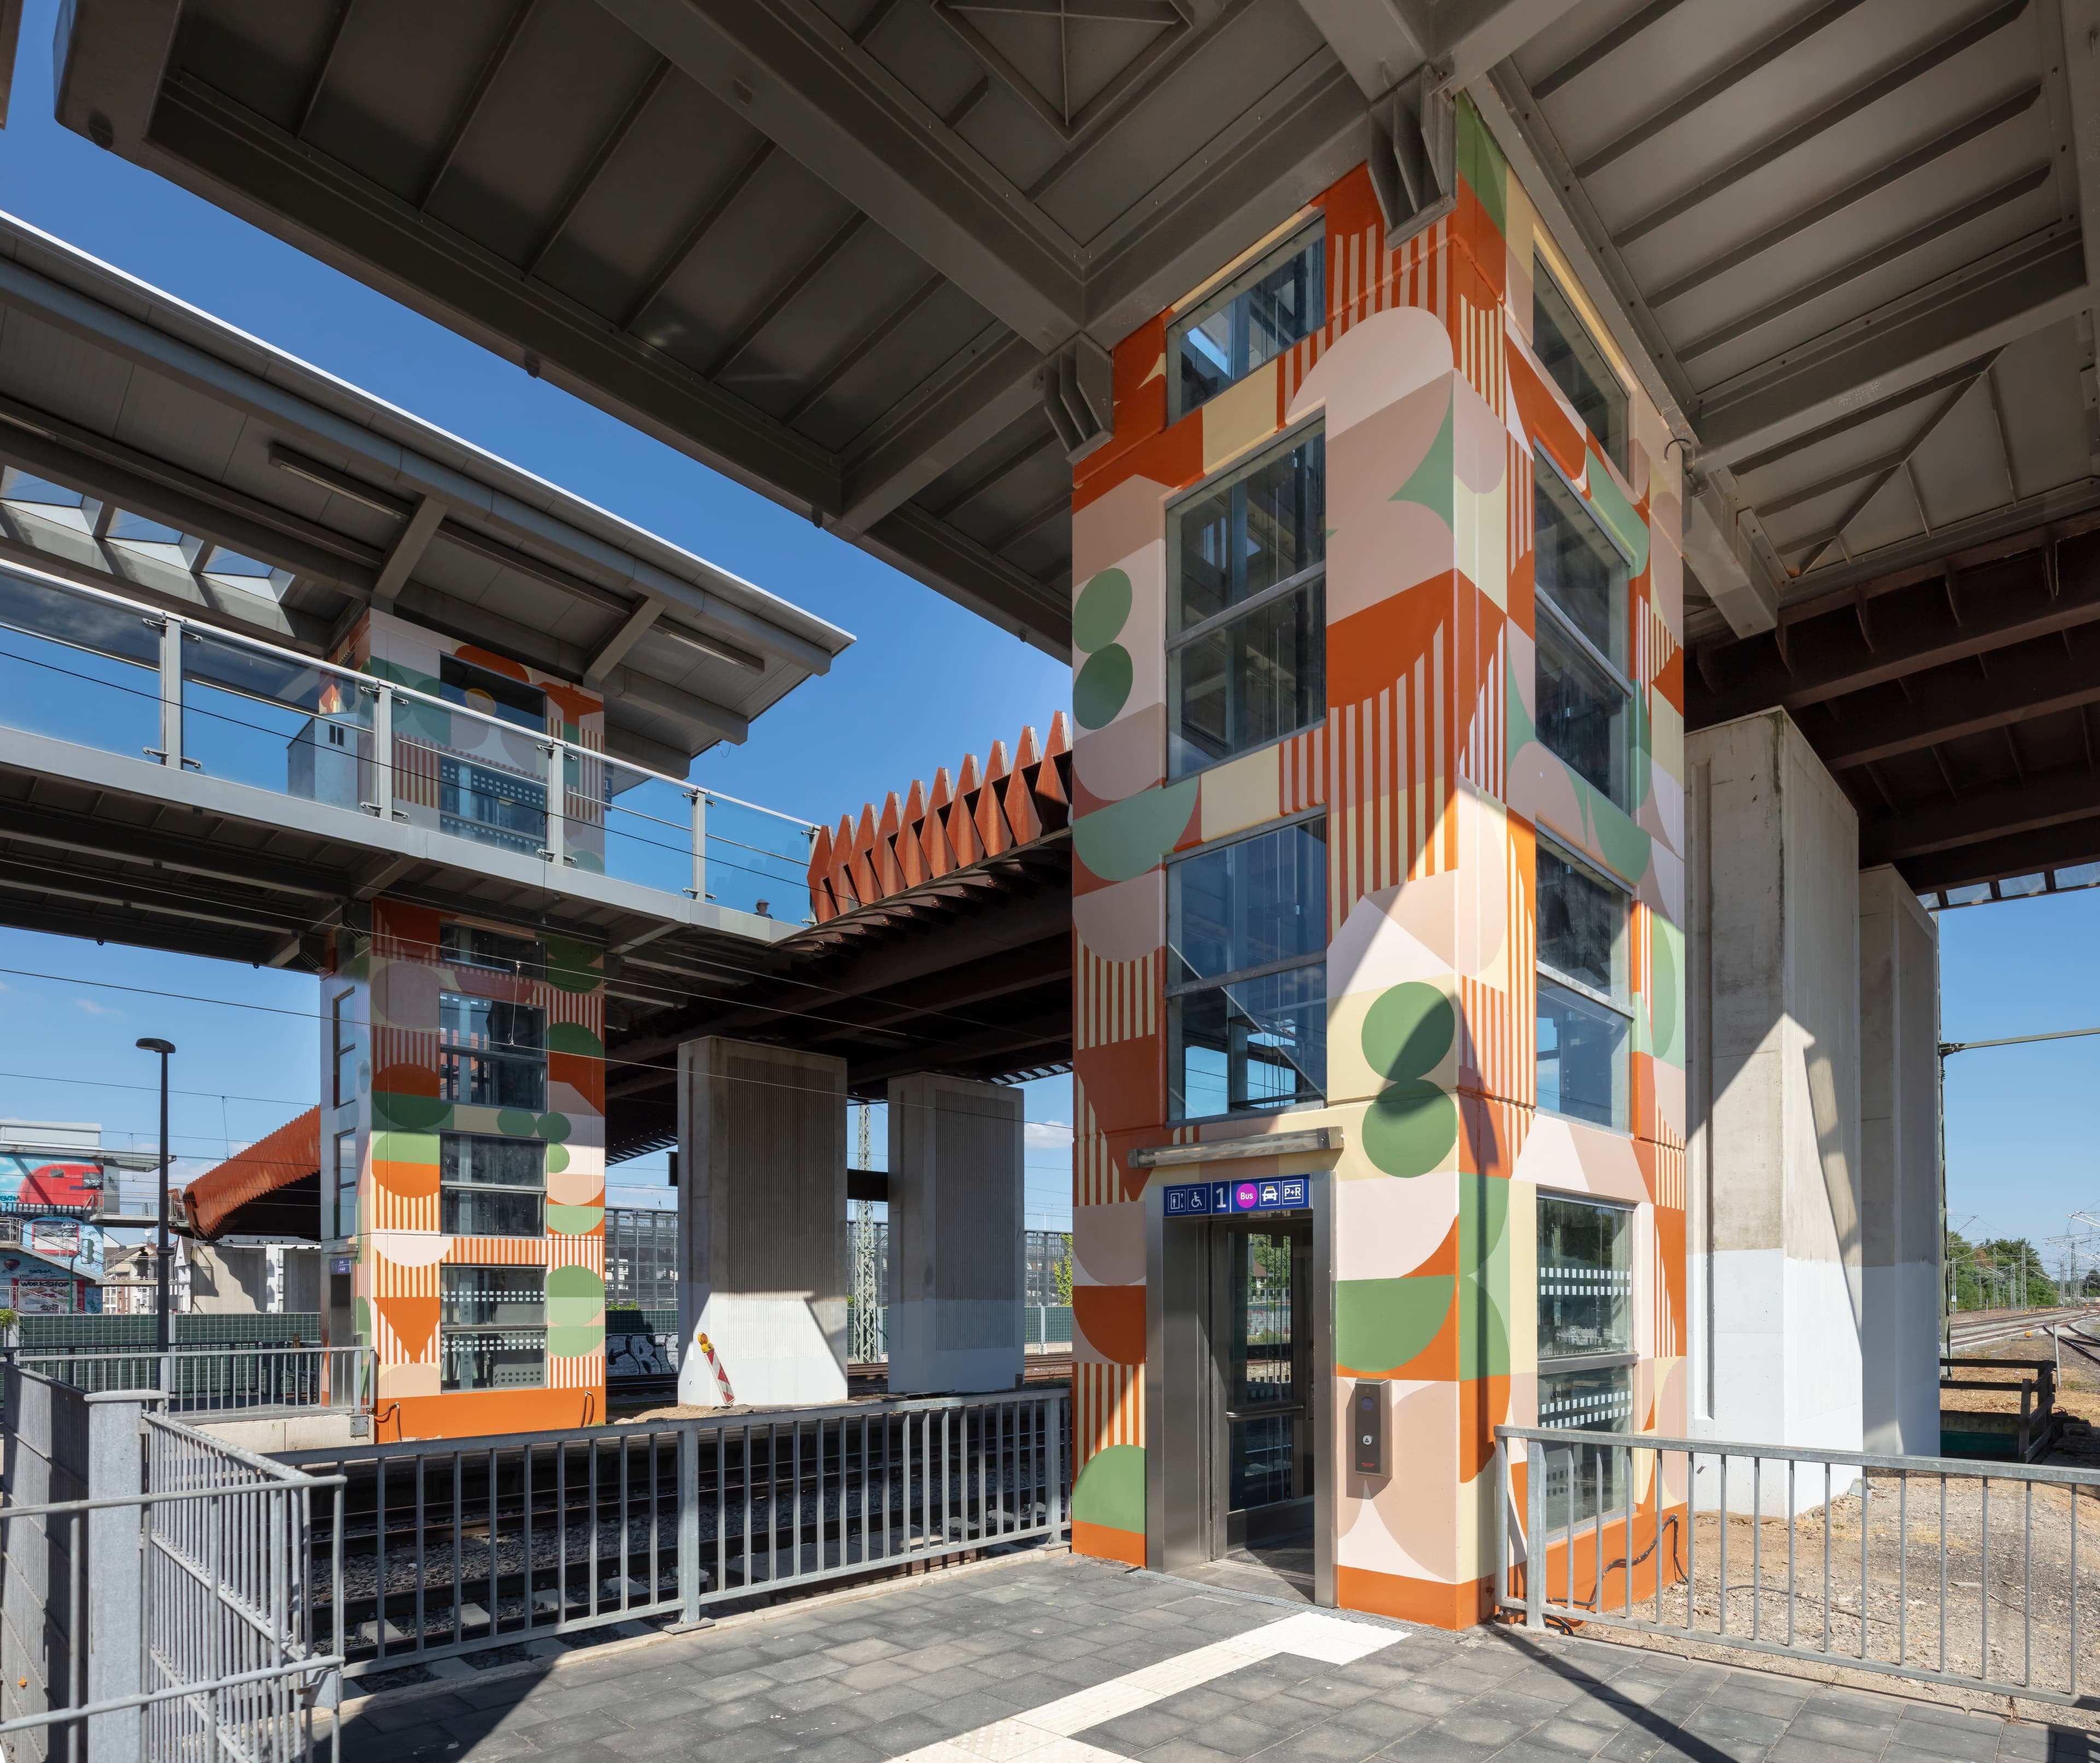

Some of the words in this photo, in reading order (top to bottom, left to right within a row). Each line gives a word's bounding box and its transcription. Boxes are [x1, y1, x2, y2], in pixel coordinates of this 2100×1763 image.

[1216, 1187, 1226, 1208] 1
[1240, 1192, 1253, 1200] Bus
[1285, 1187, 1301, 1198] P+R
